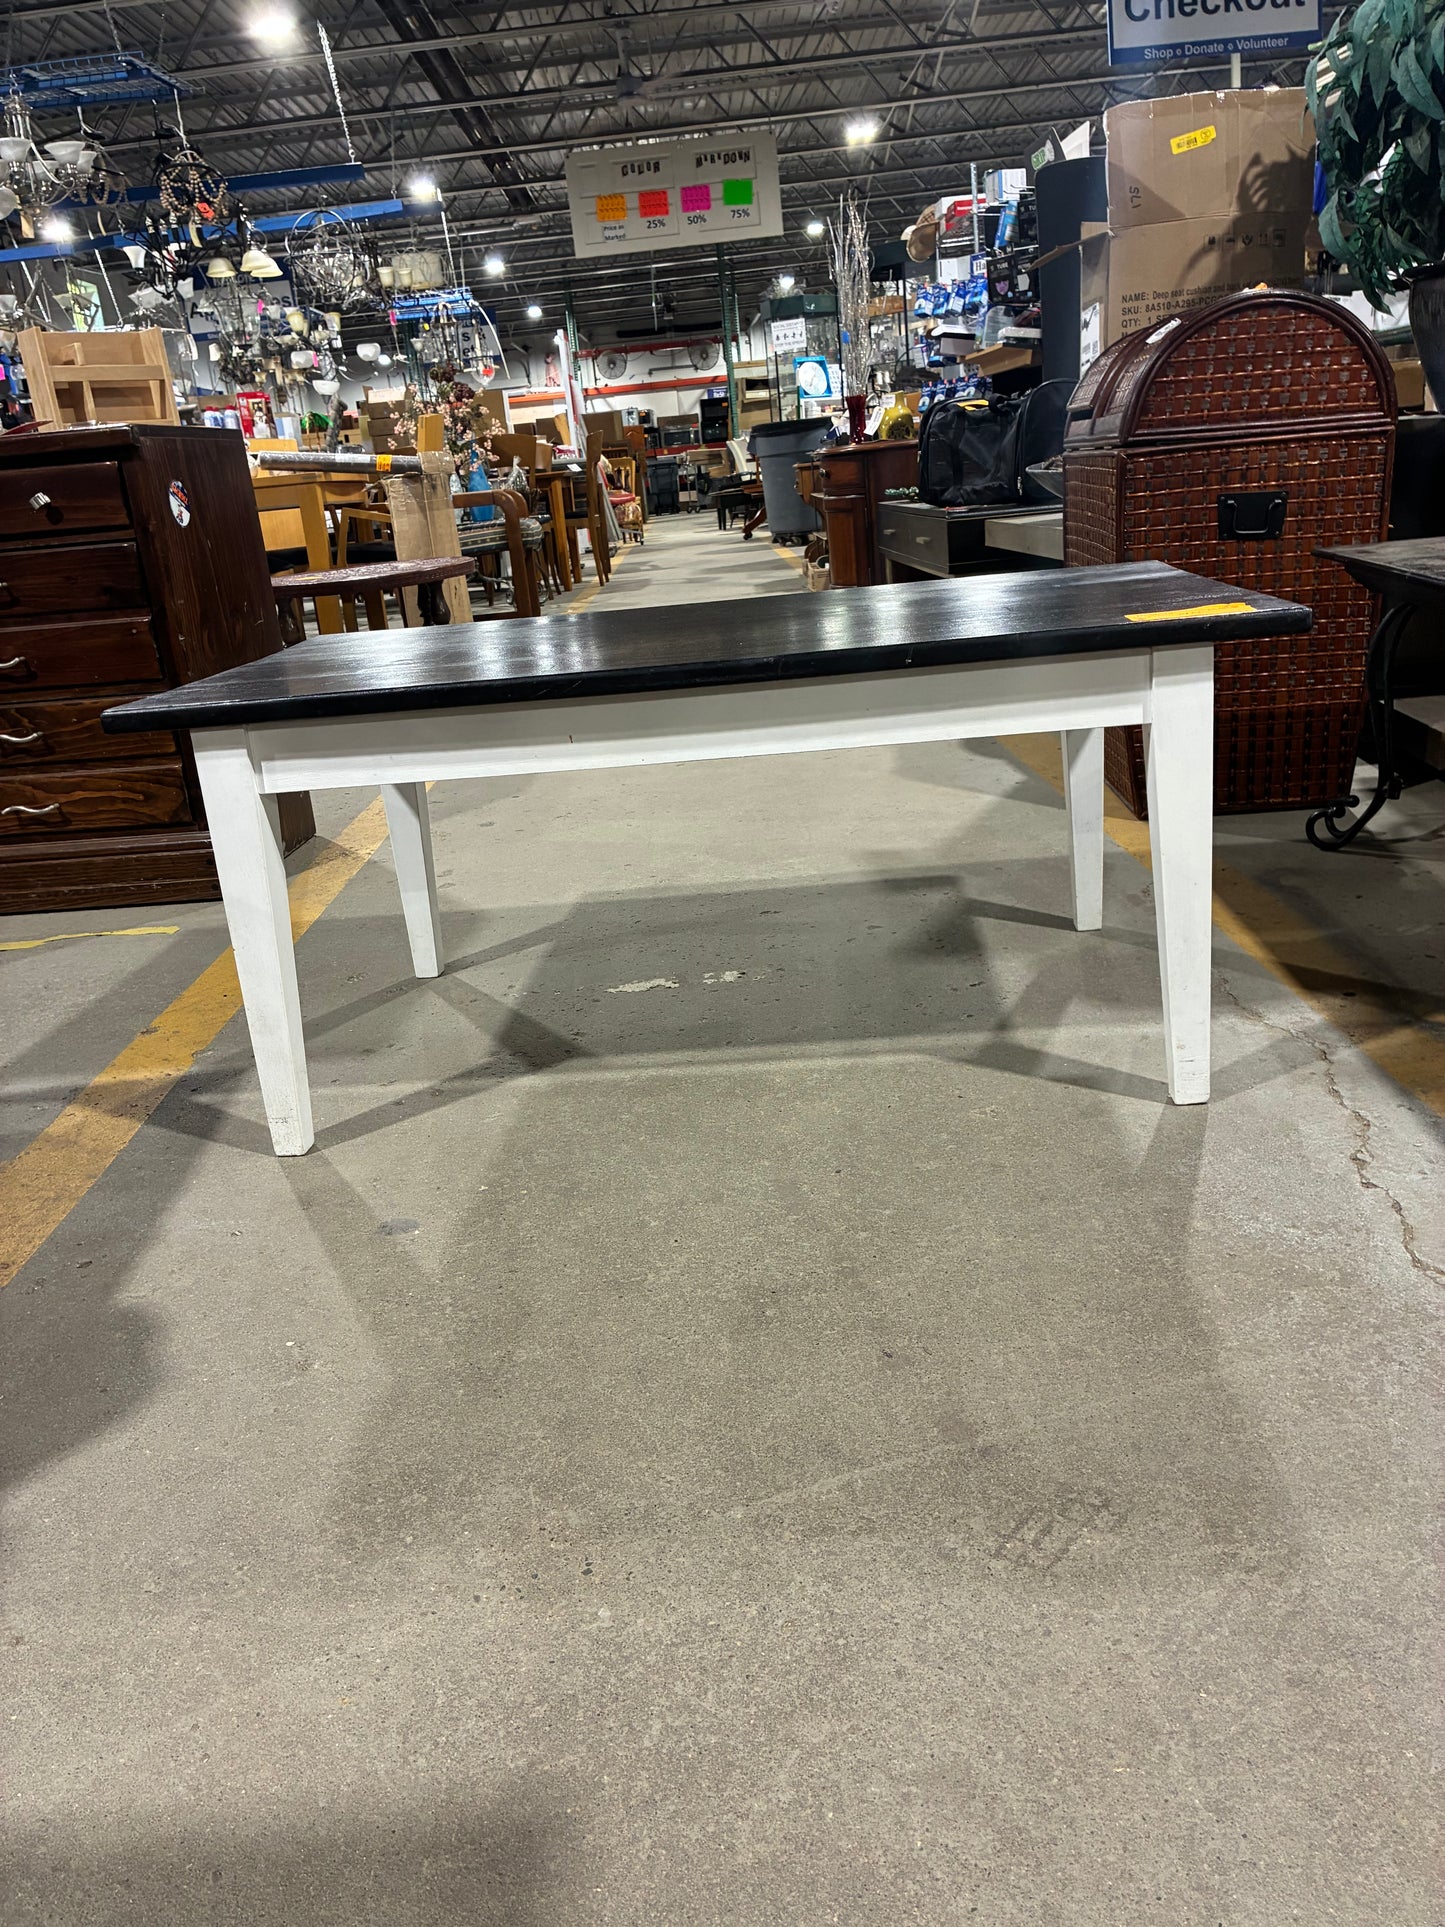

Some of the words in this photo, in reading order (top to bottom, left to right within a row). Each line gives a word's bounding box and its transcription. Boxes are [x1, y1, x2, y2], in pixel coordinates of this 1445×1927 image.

[1125, 0, 1306, 21] Chec
[1144, 47, 1174, 60] Shop
[1184, 42, 1224, 56] Donate
[1236, 37, 1289, 51] Volunteer
[621, 161, 661, 177] COLOR
[687, 214, 707, 225] 50%
[730, 208, 750, 219] 75%
[646, 218, 666, 229] 25%
[1121, 291, 1150, 304] NAME:
[1152, 290, 1170, 301] Deep
[1121, 305, 1142, 316] SKU:
[1121, 317, 1141, 329] QTY:
